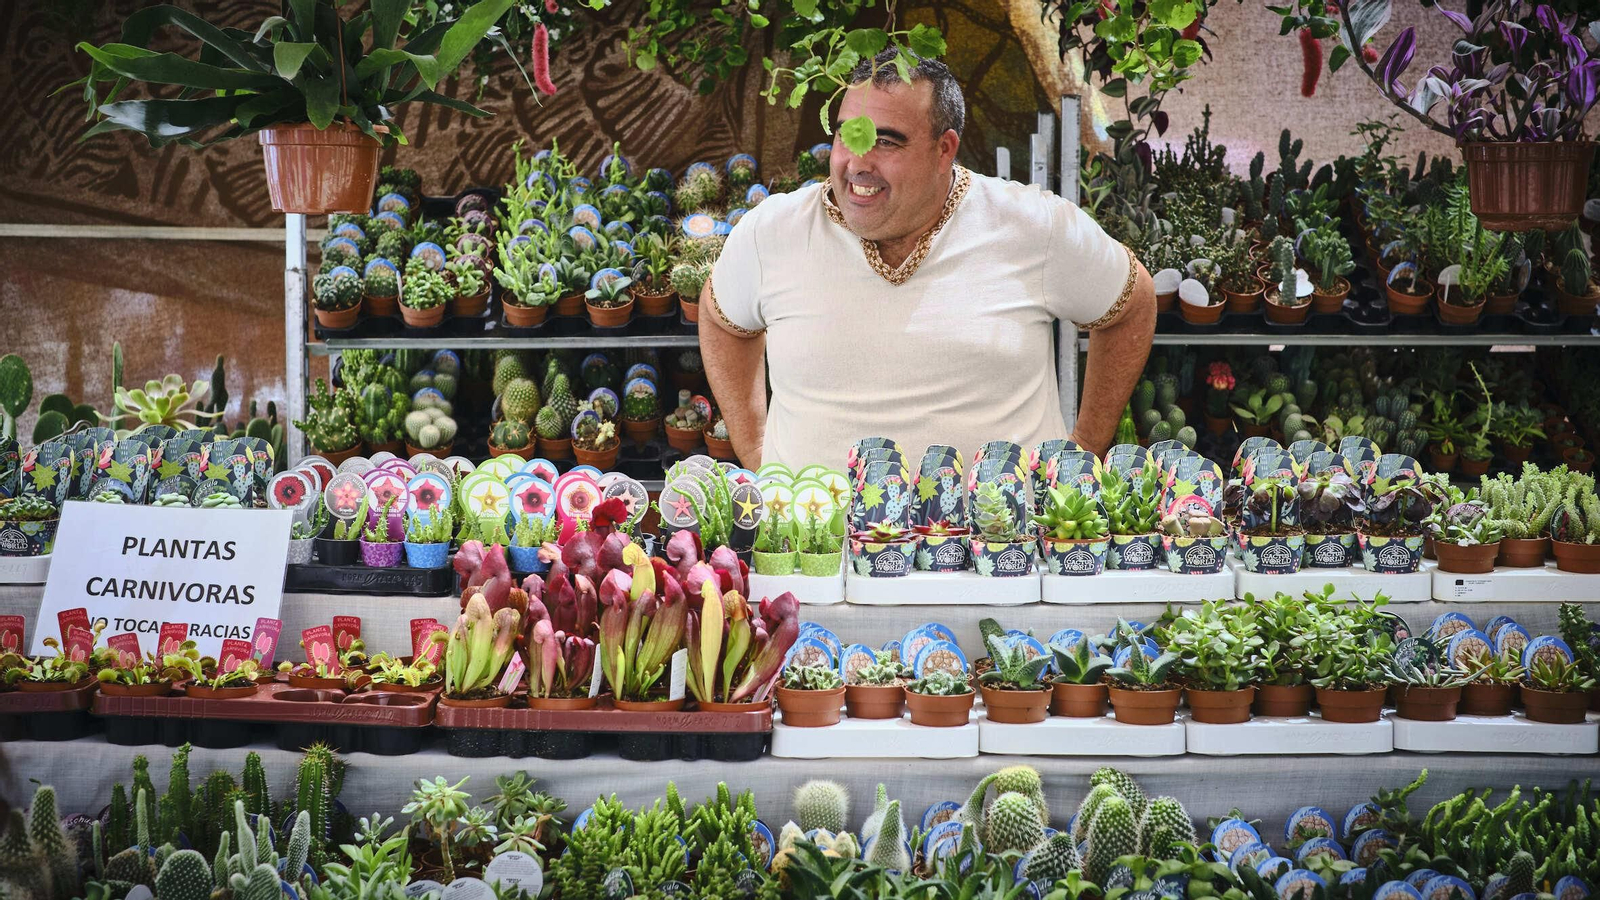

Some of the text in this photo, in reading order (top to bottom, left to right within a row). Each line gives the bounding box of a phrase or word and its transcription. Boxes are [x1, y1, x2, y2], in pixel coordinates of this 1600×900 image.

[122, 536, 236, 560] PLANTAS
[86, 577, 255, 604] CARNIVORAS
[114, 618, 170, 634] TOCA
[190, 624, 250, 639] RACIAS
[306, 628, 326, 636] PLANTA
